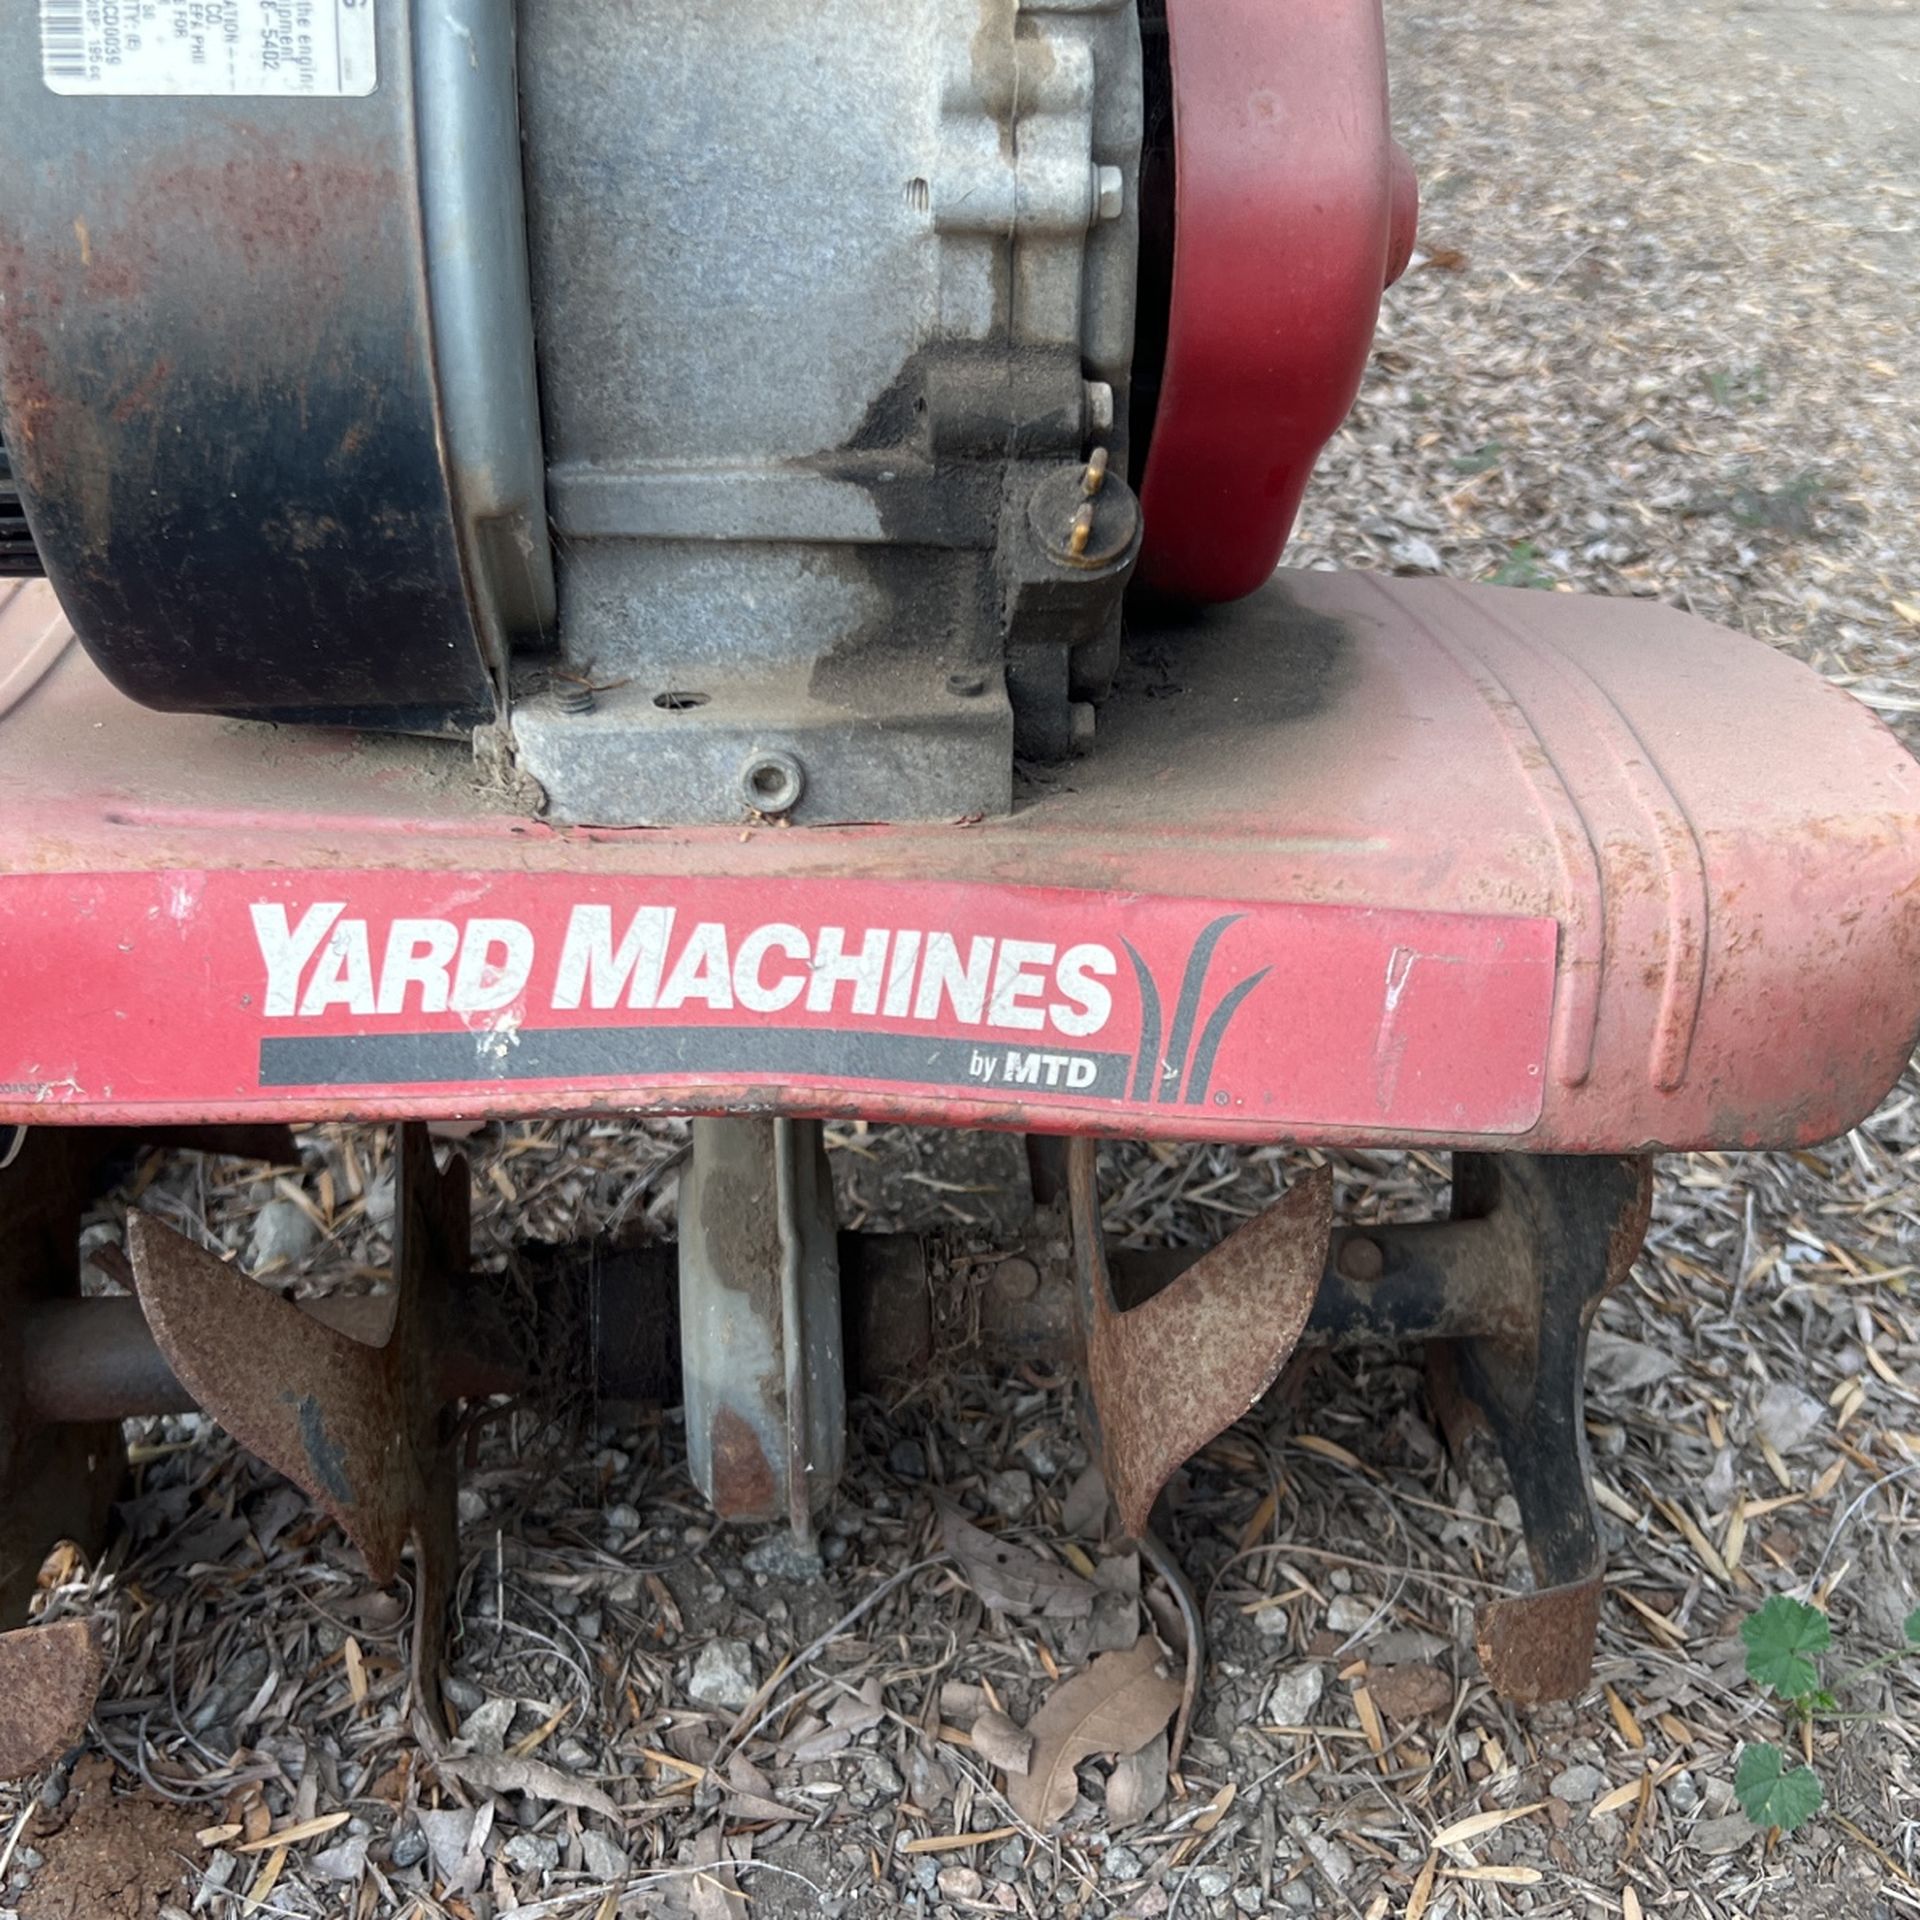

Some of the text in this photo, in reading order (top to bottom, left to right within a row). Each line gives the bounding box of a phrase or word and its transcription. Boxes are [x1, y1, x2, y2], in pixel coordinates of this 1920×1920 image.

[249, 902, 1117, 1037] YARD MACHINES
[969, 1050, 1098, 1088] by MTD
